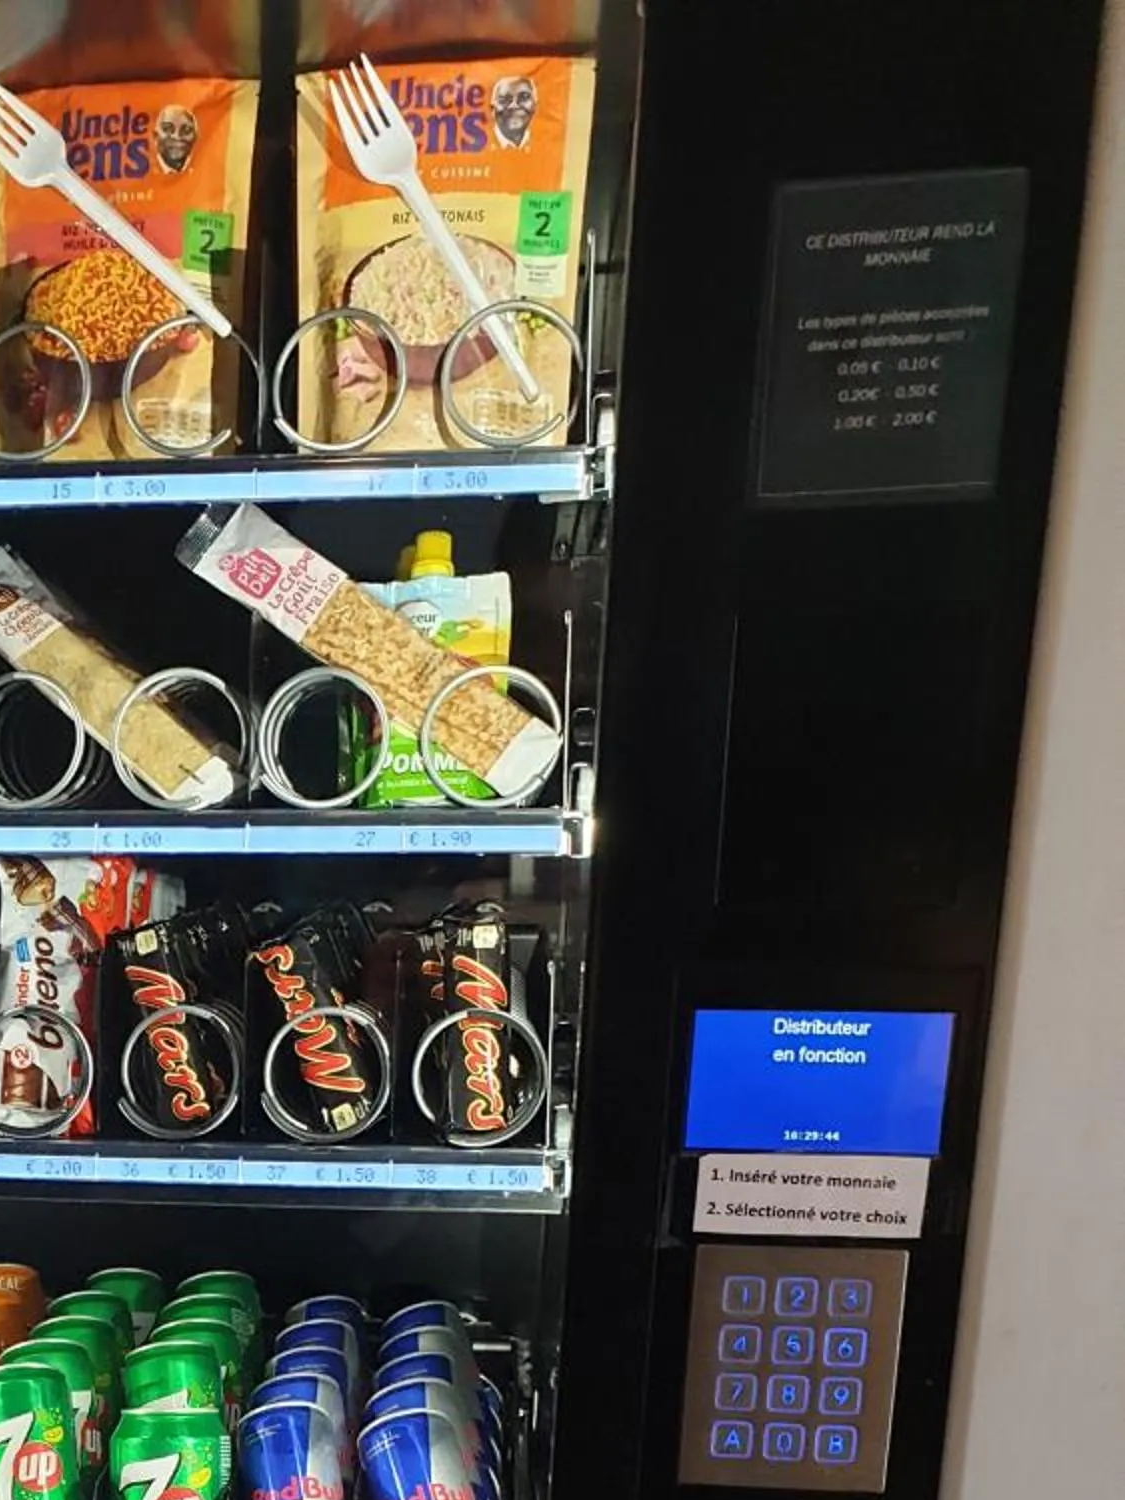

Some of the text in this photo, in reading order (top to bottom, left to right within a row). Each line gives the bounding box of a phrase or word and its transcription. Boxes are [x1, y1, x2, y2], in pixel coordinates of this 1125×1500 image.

[389, 74, 486, 112] Uncle
[61, 105, 151, 142] Uncle
[534, 213, 552, 237] 2
[199, 229, 216, 254] 2
[806, 234, 824, 250] CE
[827, 225, 929, 249] DISTRIBUTEUR
[932, 222, 974, 239] REND
[863, 248, 933, 267] MONNAIE
[278, 548, 316, 593] Crêpe
[123, 831, 162, 848] 1.00
[354, 830, 472, 847] 27 1.90
[249, 943, 366, 1092] Mars
[773, 1017, 872, 1037] Distributeur
[124, 964, 211, 1121] Mars
[452, 953, 508, 1131] Mars
[772, 1046, 867, 1064] en fonction
[44, 1160, 82, 1177] 2.00
[187, 1164, 226, 1180] 1.50
[266, 1165, 375, 1183] 37 1.50
[416, 1169, 528, 1187] 38 1.50
[710, 1167, 897, 1191] 1. Inséré votre monnaie
[706, 1201, 908, 1226] 2. Sélectionné votre choix
[741, 1286, 749, 1303] 1
[791, 1285, 806, 1307] 2
[843, 1288, 858, 1309] 3
[734, 1335, 747, 1352] 4
[786, 1335, 800, 1356] 5
[838, 1338, 854, 1359] 6
[731, 1382, 743, 1401] 7
[782, 1384, 796, 1404] 8
[833, 1386, 850, 1406] 9
[725, 1430, 740, 1449] A
[828, 1435, 844, 1454] B
